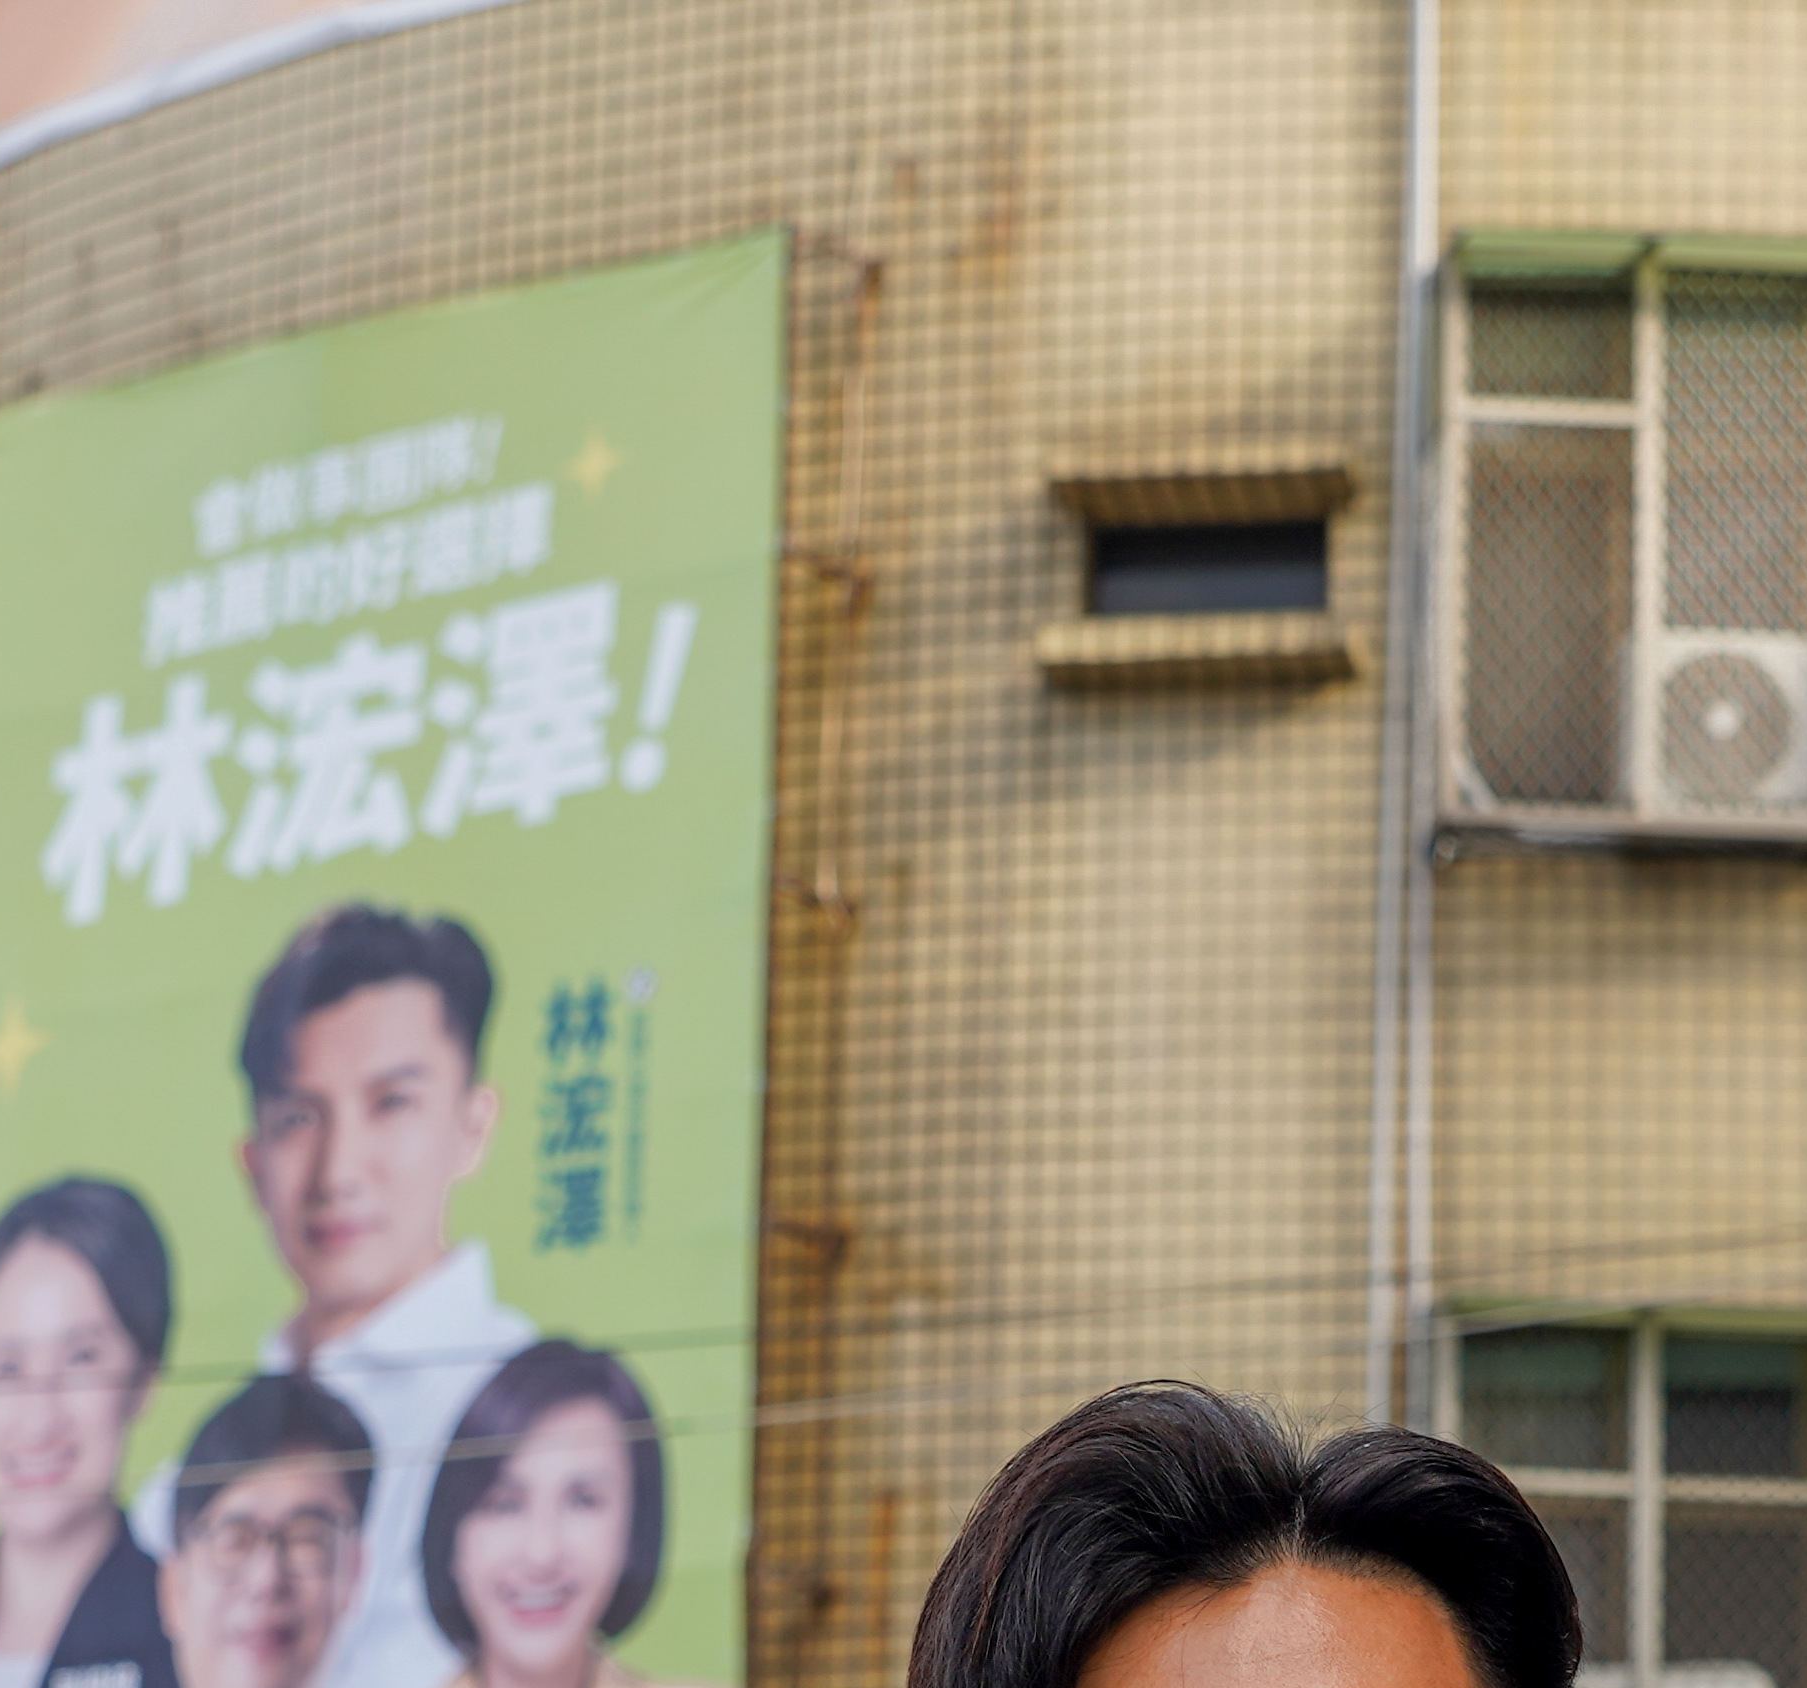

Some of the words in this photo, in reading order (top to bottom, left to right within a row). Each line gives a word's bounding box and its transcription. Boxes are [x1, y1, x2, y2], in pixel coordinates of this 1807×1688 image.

[40, 579, 698, 929] 林浤澤!
[535, 974, 614, 1253] 林浤澤
